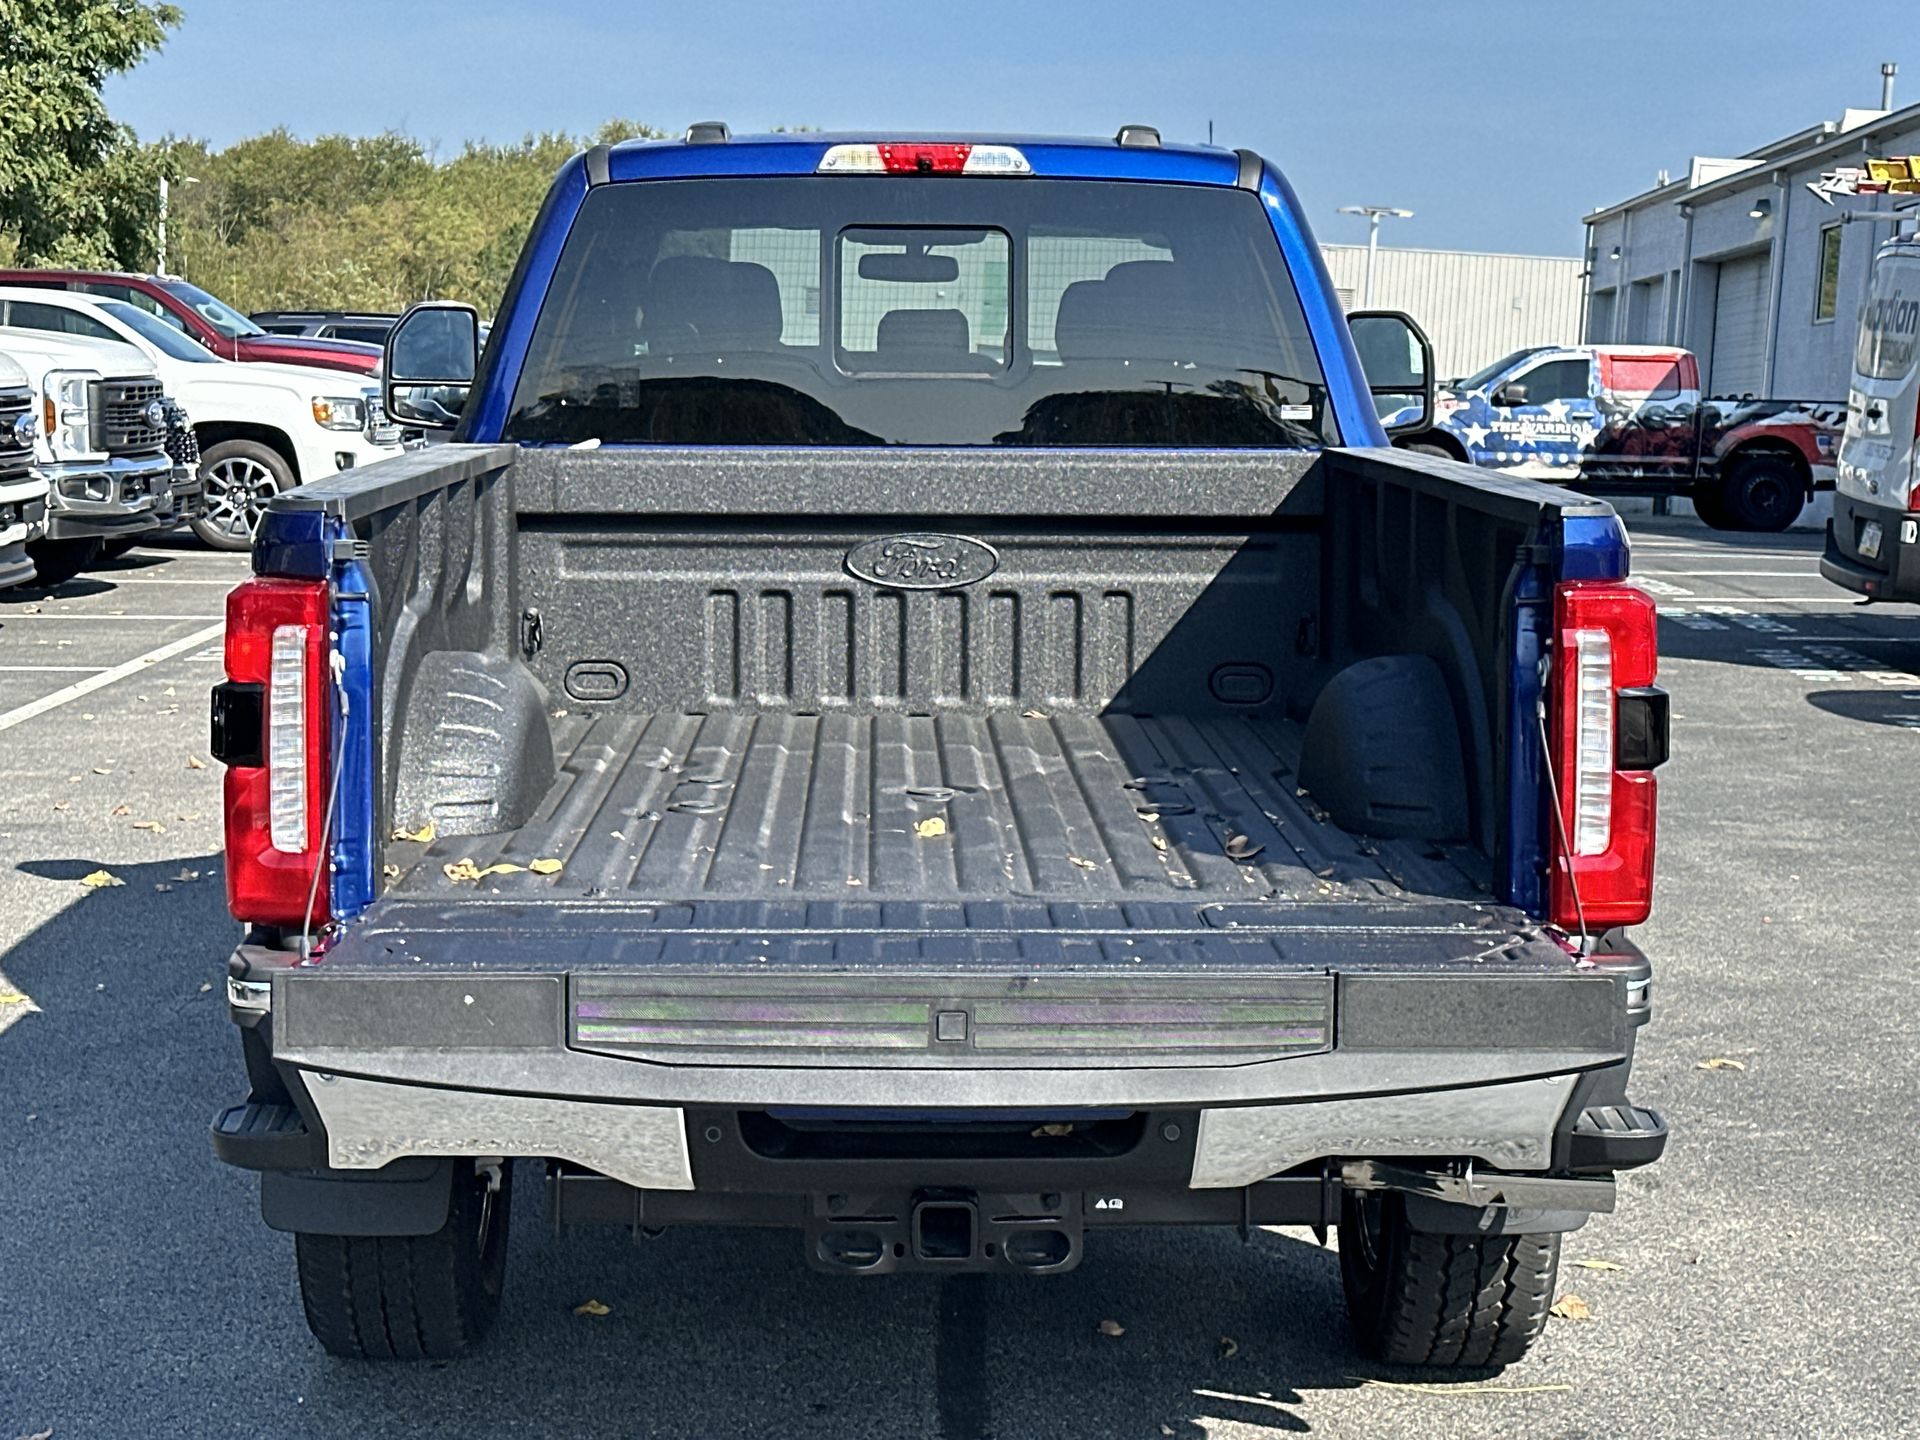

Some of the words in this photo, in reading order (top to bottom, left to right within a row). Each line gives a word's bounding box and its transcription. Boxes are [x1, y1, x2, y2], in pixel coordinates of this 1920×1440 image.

[1490, 421, 1520, 433] THE
[1520, 421, 1593, 435] WARRIOR
[873, 539, 969, 579] Ford
